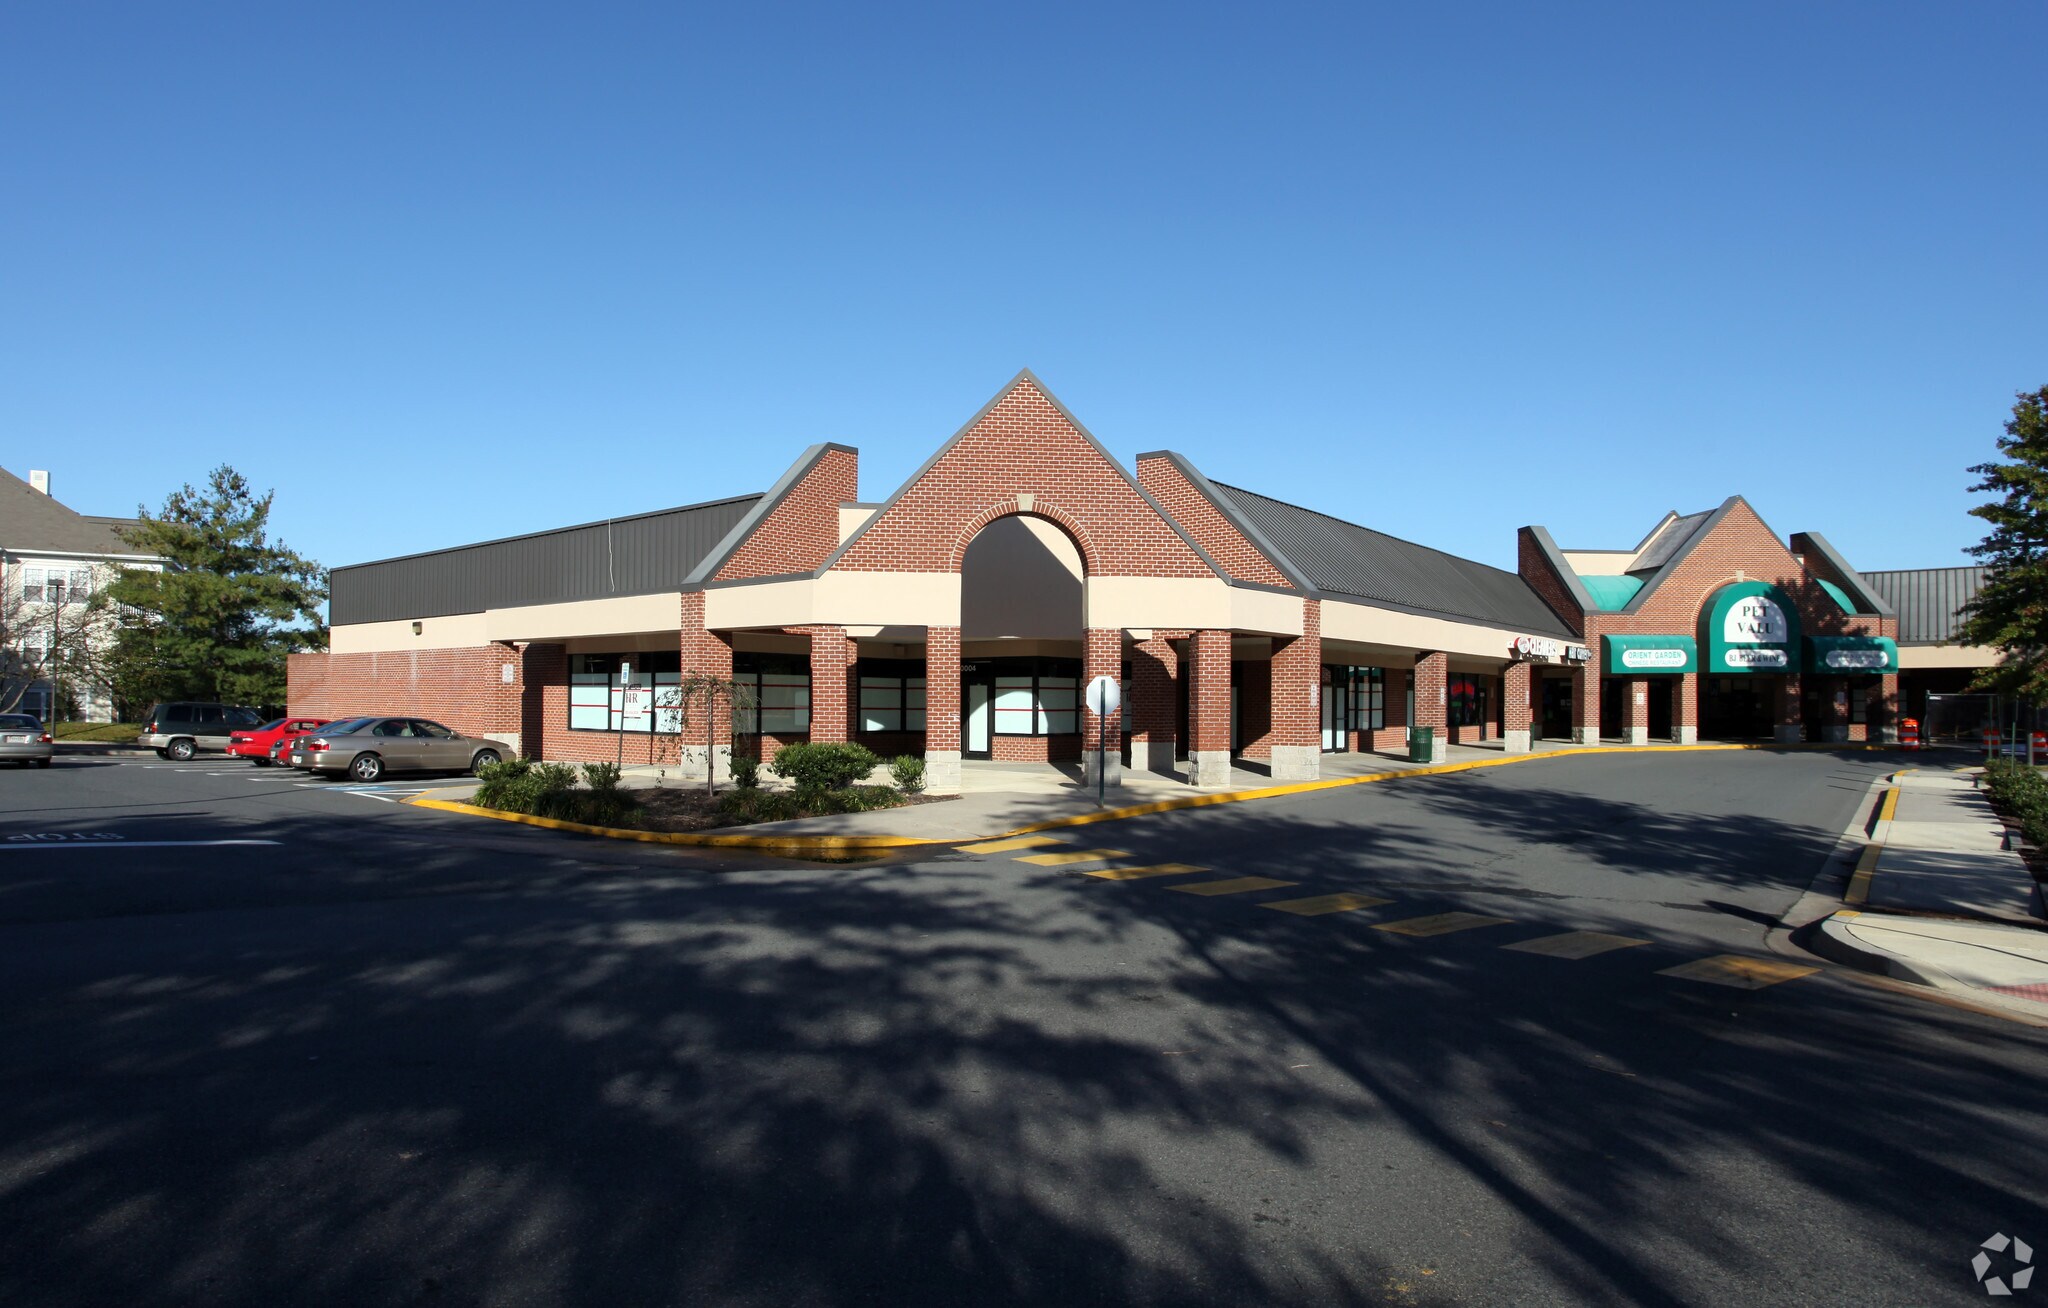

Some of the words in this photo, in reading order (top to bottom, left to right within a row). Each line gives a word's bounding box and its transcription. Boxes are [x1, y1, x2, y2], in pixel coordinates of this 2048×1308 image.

[1743, 606, 1769, 617] PET
[1738, 622, 1774, 634] VALU
[1628, 651, 1652, 659] ORIENT
[1654, 651, 1682, 659] GARDEN
[7, 832, 125, 841] STOP
